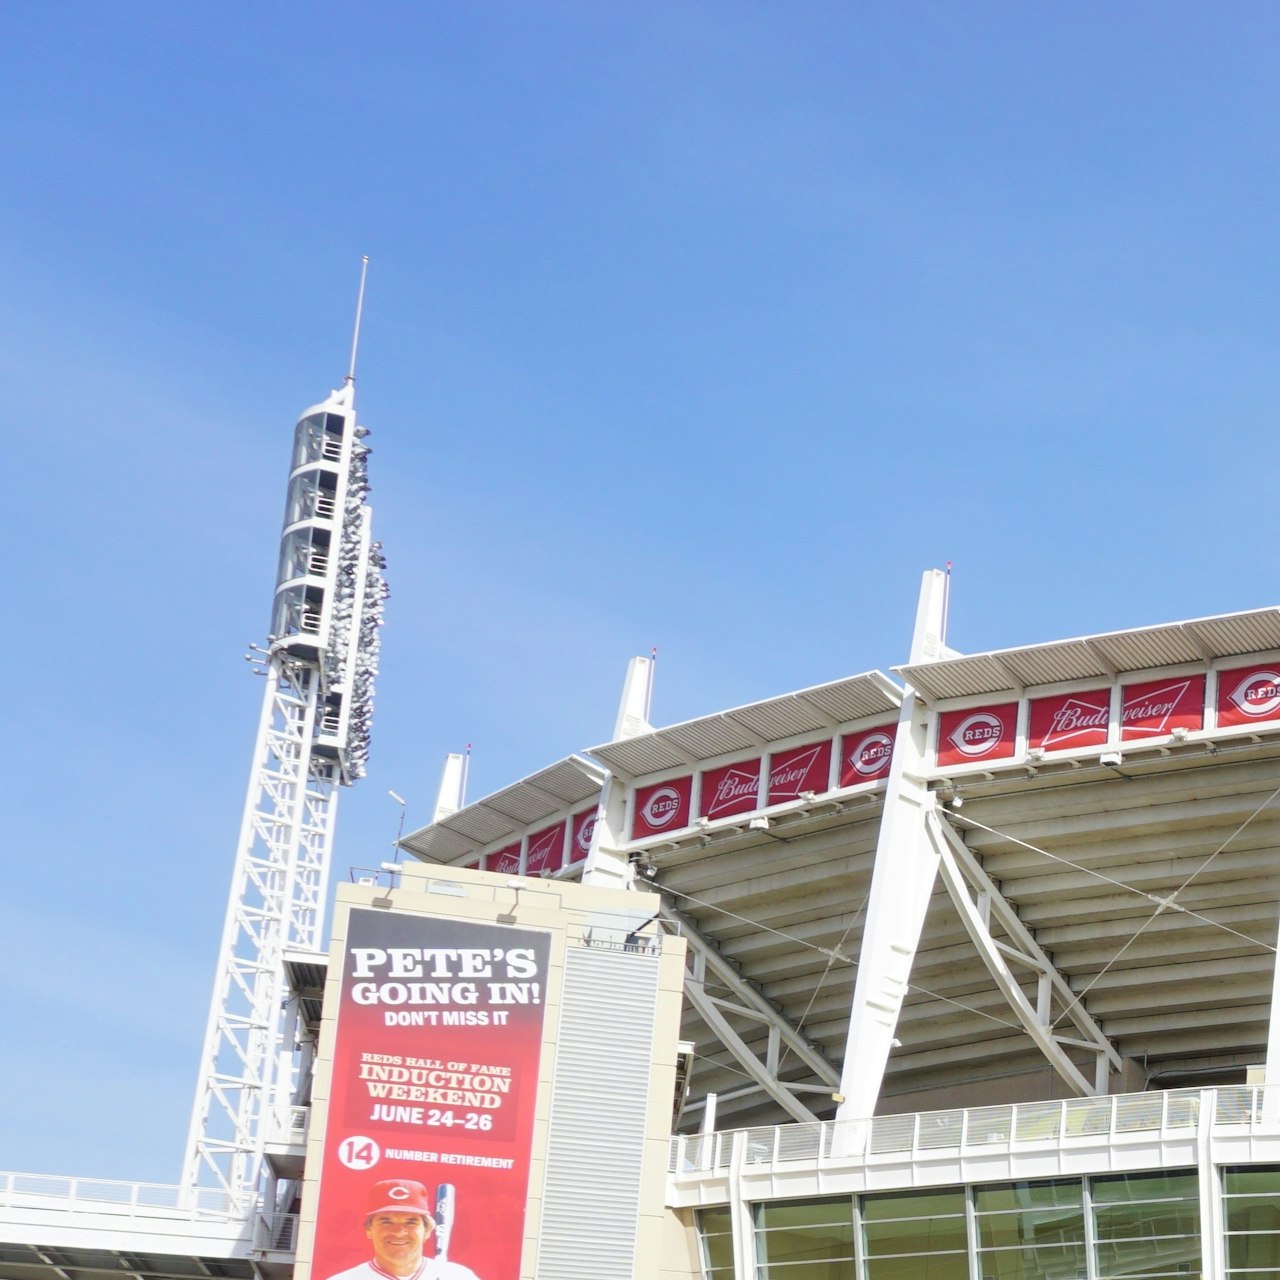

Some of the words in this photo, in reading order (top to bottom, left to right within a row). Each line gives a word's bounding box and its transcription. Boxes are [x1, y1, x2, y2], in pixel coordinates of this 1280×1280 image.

[964, 725, 1001, 741] REDS
[861, 744, 892, 762] REDS
[650, 798, 679, 815] REDS
[350, 948, 538, 979] PETE'S
[351, 982, 479, 1005] GOING
[487, 982, 541, 1005] IN!
[384, 1011, 440, 1026] DON'T
[443, 1011, 489, 1026] MISS
[493, 1010, 509, 1026] IT
[361, 1052, 402, 1065] REDS
[405, 1057, 444, 1070] HALL
[447, 1061, 467, 1072] OF
[470, 1063, 512, 1077] FAME
[358, 1063, 512, 1093] INDUCTION
[366, 1081, 502, 1109] WEEKEND
[370, 1104, 425, 1125] JUNE
[345, 1140, 374, 1165] 14
[385, 1148, 439, 1163] NUMBER
[440, 1153, 515, 1169] RETIREMENT
